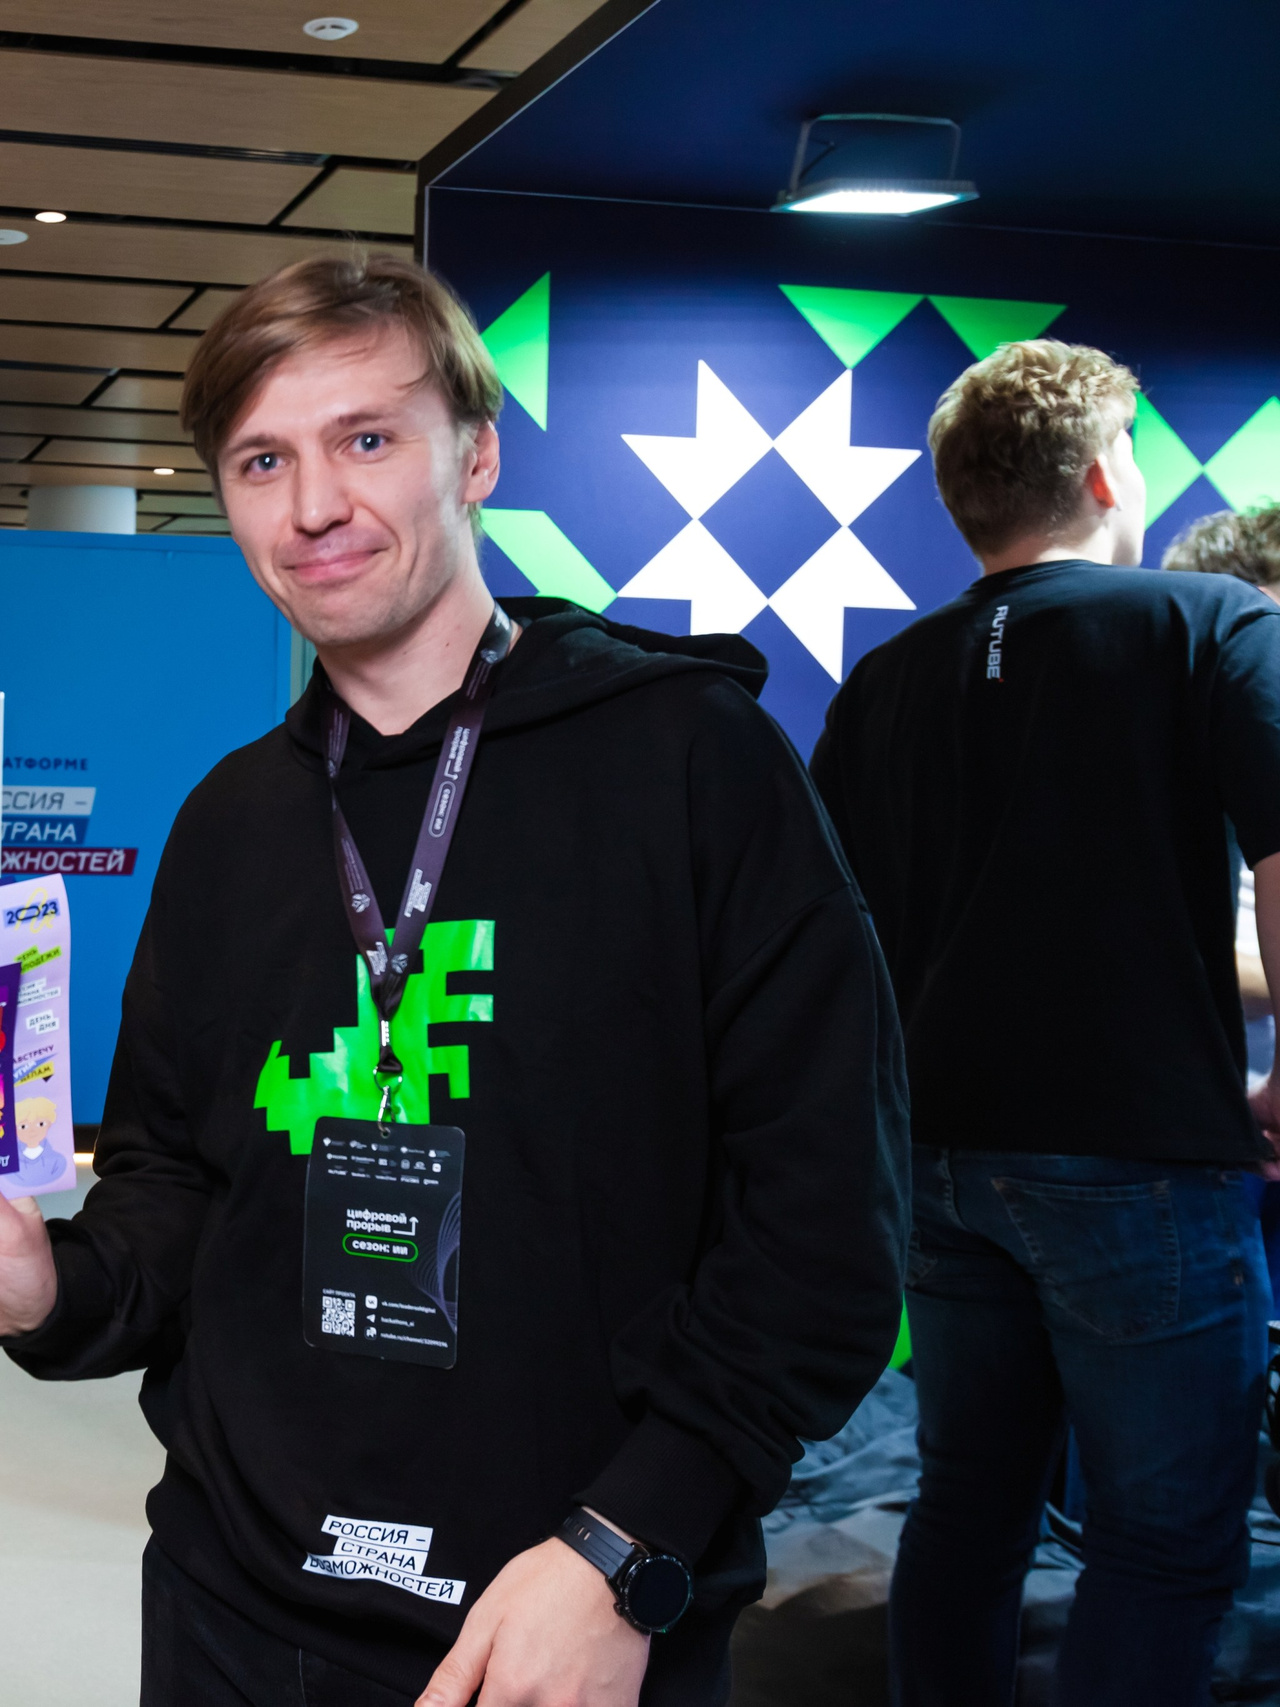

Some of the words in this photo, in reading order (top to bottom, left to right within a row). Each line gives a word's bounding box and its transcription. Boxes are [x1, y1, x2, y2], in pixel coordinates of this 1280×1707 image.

[986, 605, 1009, 679] RUTUBE
[3, 757, 88, 770] АТФОРМЕ
[2, 791, 65, 811] ССИЯ
[2, 822, 77, 842] ТРАНА
[6, 901, 59, 925] 2023
[346, 1208, 407, 1224] цифровой
[346, 1219, 391, 1233] прорыв
[352, 1240, 390, 1253] сезон:
[392, 1245, 408, 1256] ии
[328, 1520, 409, 1545] РОССИЯ
[340, 1541, 416, 1570] СТРАНА
[309, 1556, 455, 1600] ВОЗМОЖНОСТЕЙ
